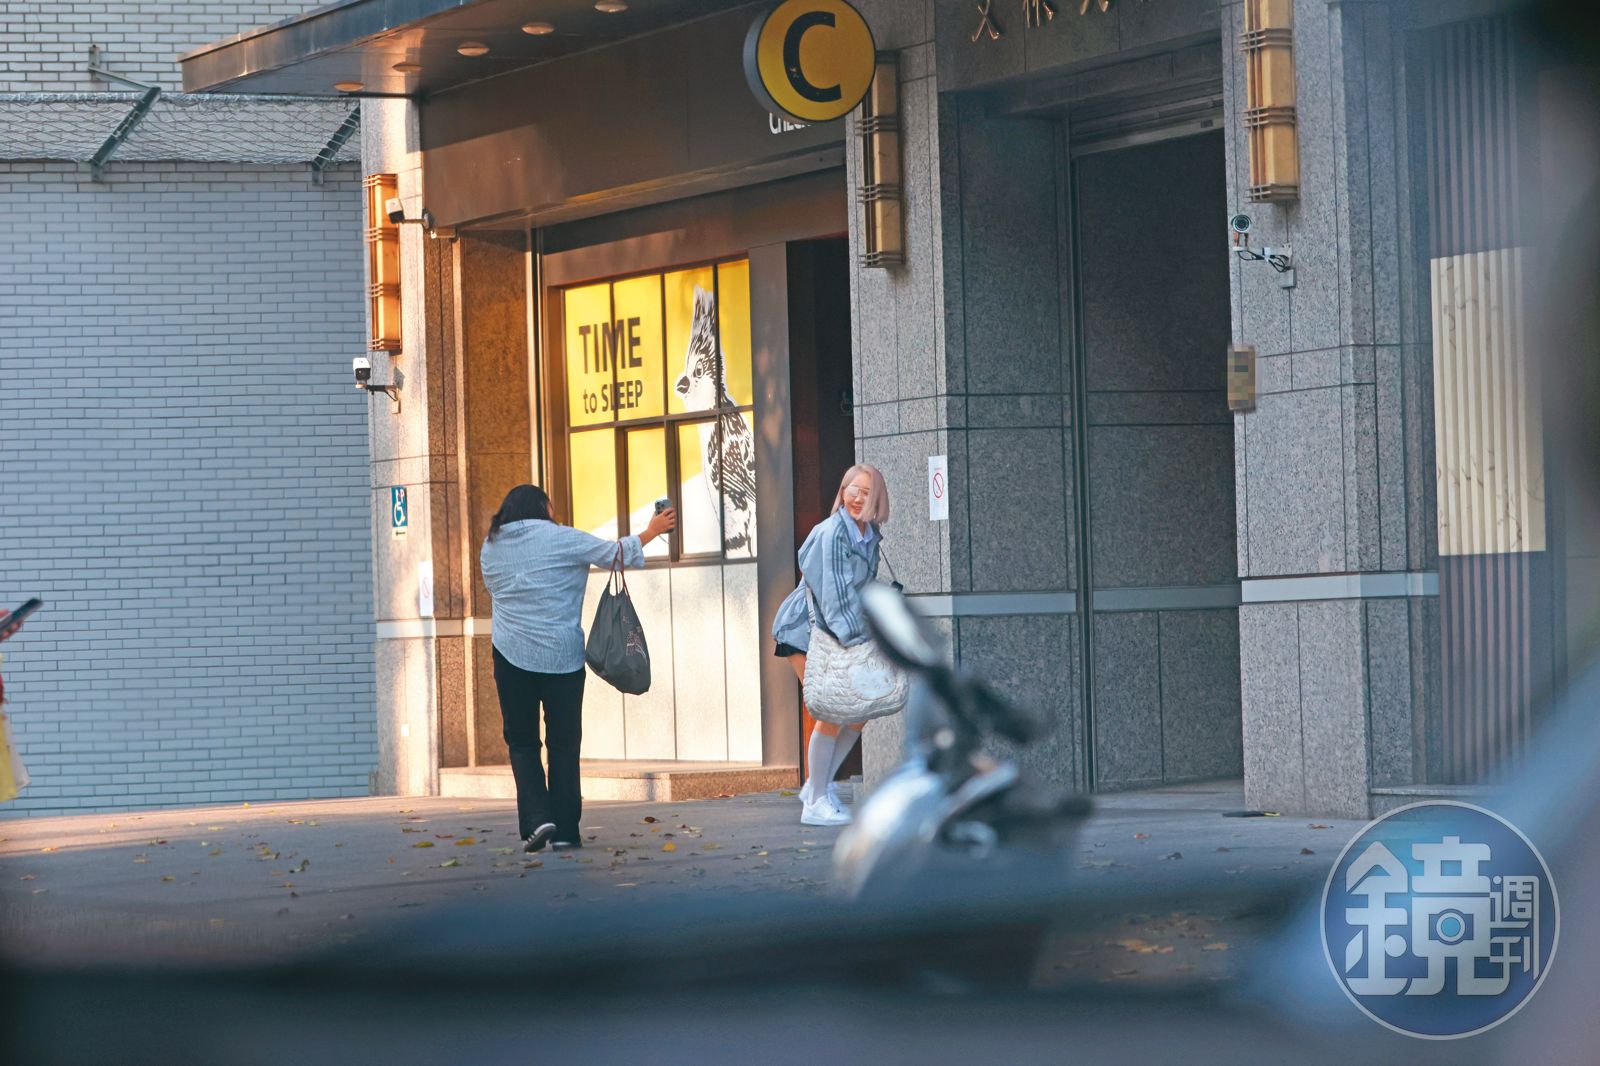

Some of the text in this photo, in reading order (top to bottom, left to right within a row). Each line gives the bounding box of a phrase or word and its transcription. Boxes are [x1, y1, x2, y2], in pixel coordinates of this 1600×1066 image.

[783, 11, 842, 102] C
[579, 317, 642, 374] TIME
[583, 380, 643, 414] to SLEEP
